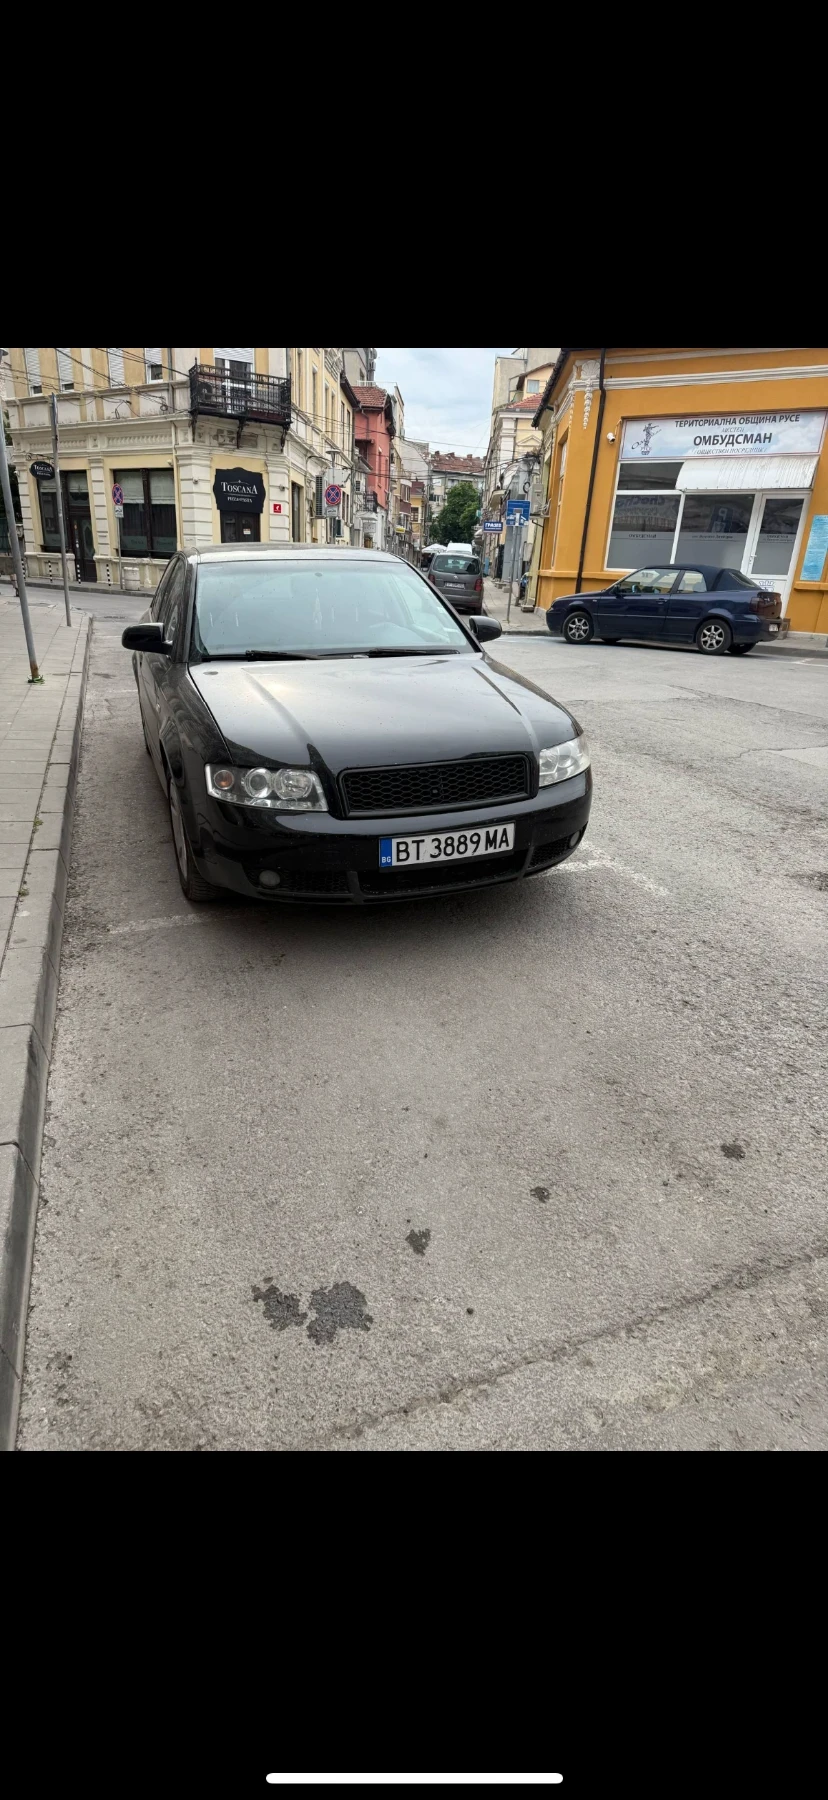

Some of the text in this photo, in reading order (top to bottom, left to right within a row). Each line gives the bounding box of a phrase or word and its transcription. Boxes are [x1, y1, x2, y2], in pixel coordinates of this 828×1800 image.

[675, 414, 800, 428] ТЕРИТОРИАЛНА ОБЩИНА РУСЕ
[693, 433, 773, 447] ОМБУДСМАН
[221, 482, 258, 495] TOSCANA
[396, 827, 510, 863] BT 3889 MA
[381, 856, 391, 864] BG
